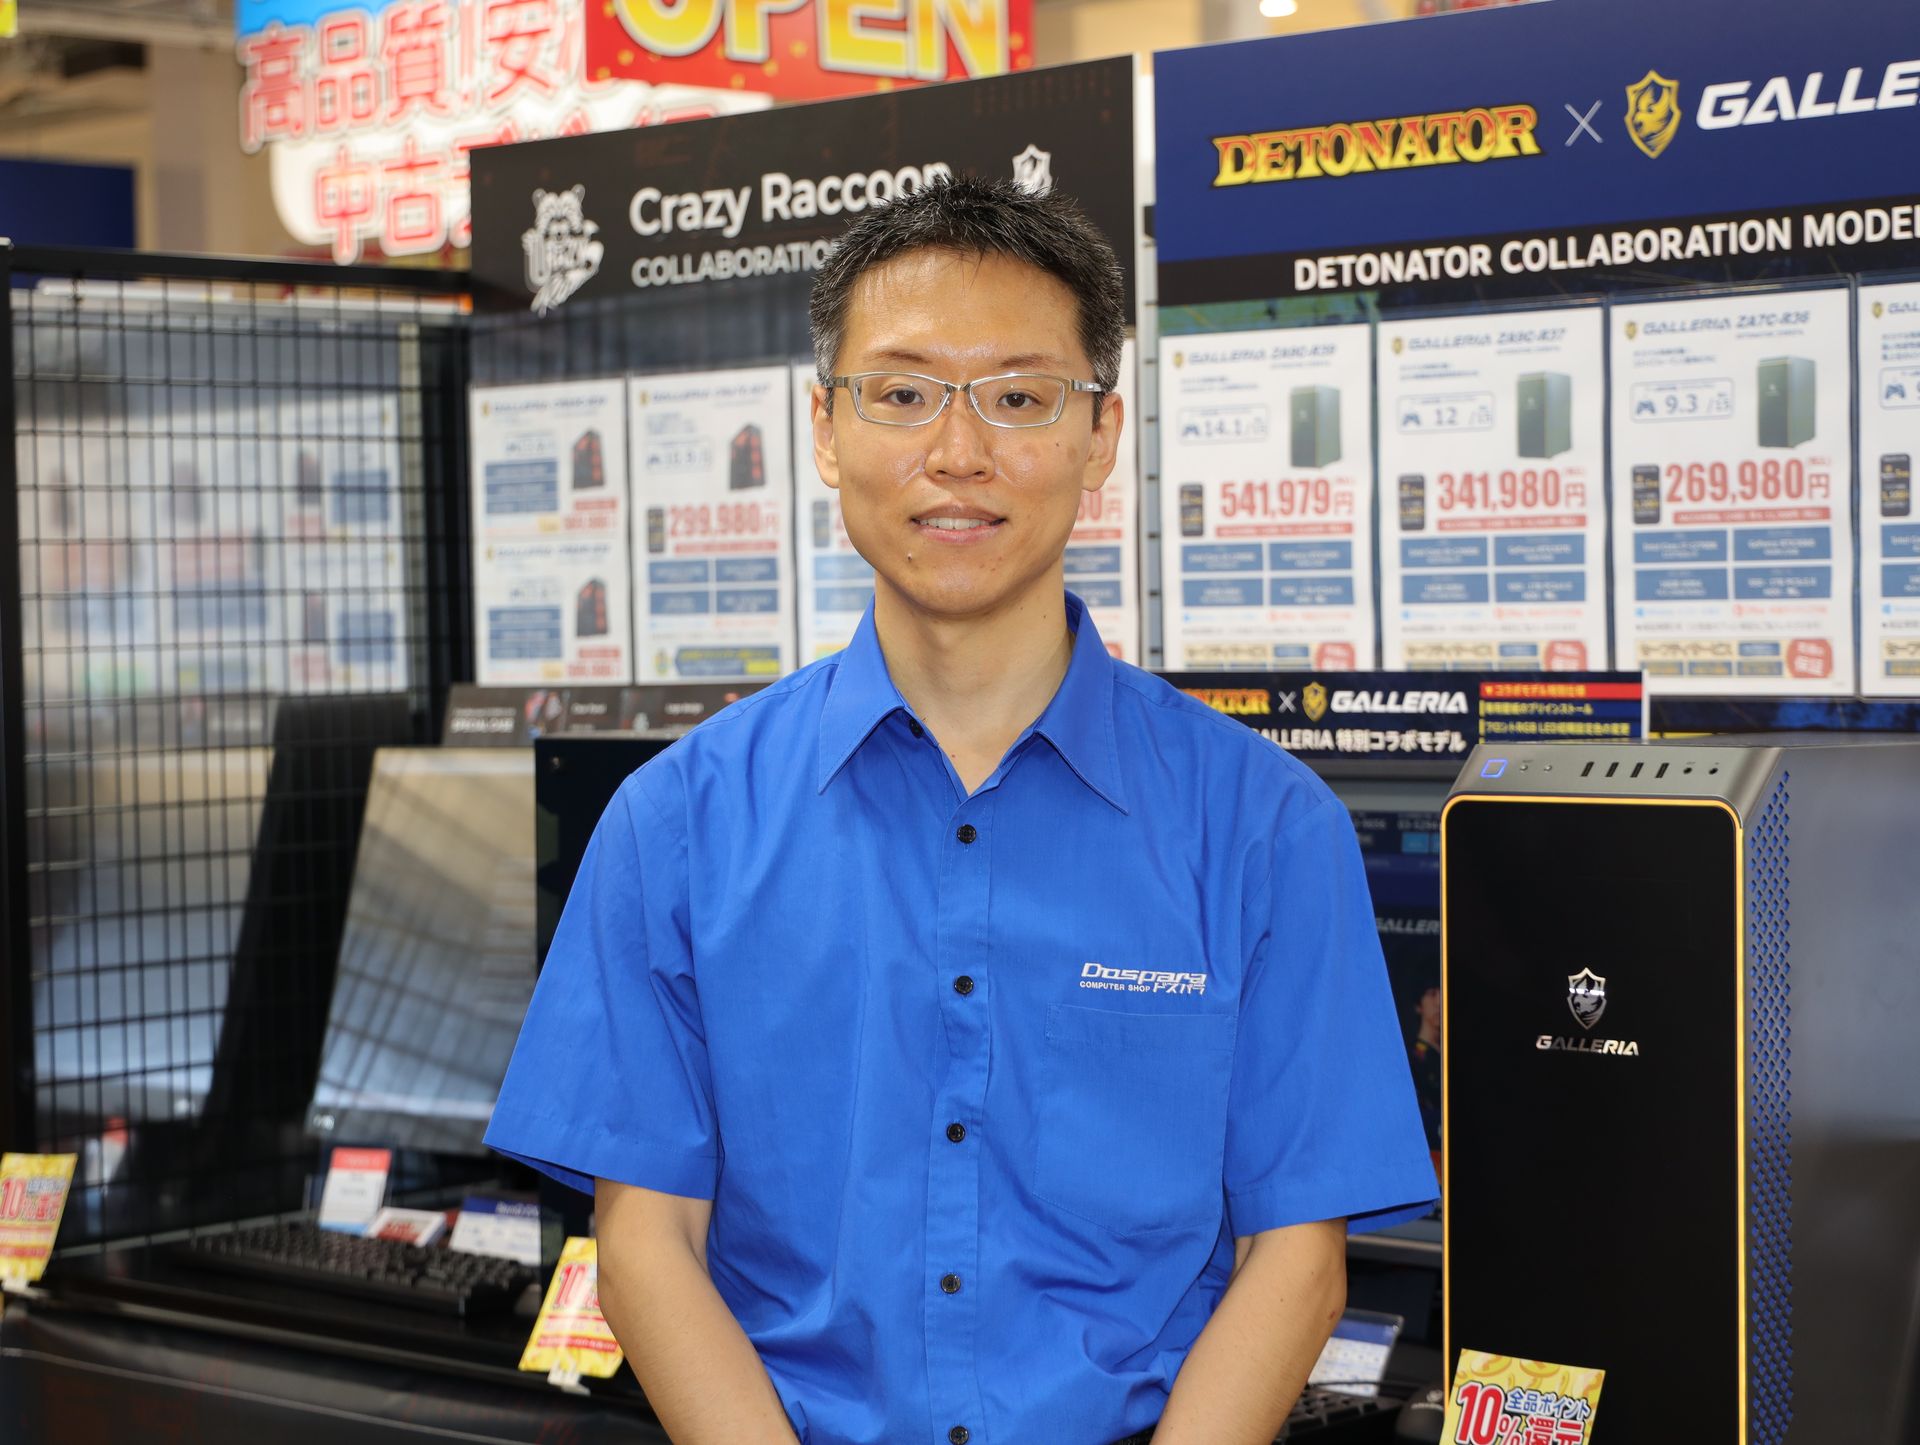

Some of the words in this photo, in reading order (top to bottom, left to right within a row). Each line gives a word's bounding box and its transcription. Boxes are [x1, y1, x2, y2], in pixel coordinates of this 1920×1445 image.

[1212, 104, 1542, 188] DETONATOR
[628, 184, 752, 238] Crazy
[631, 240, 837, 289] COLLABORATIO
[1294, 244, 1494, 291] DETONATOR
[1501, 217, 1793, 274] COLLABORATION
[1664, 394, 1698, 415] 9.3
[1330, 690, 1469, 714] GALLERIA
[1252, 728, 1335, 751] ALLERIA
[1336, 728, 1467, 753] 特別コラボモデル
[1080, 962, 1208, 985] Dospara
[1079, 980, 1125, 991] COMPUTER
[1127, 983, 1151, 993] SHOP
[1535, 1035, 1640, 1057] GALLERIA
[1506, 1388, 1591, 1419] 全品ポイント
